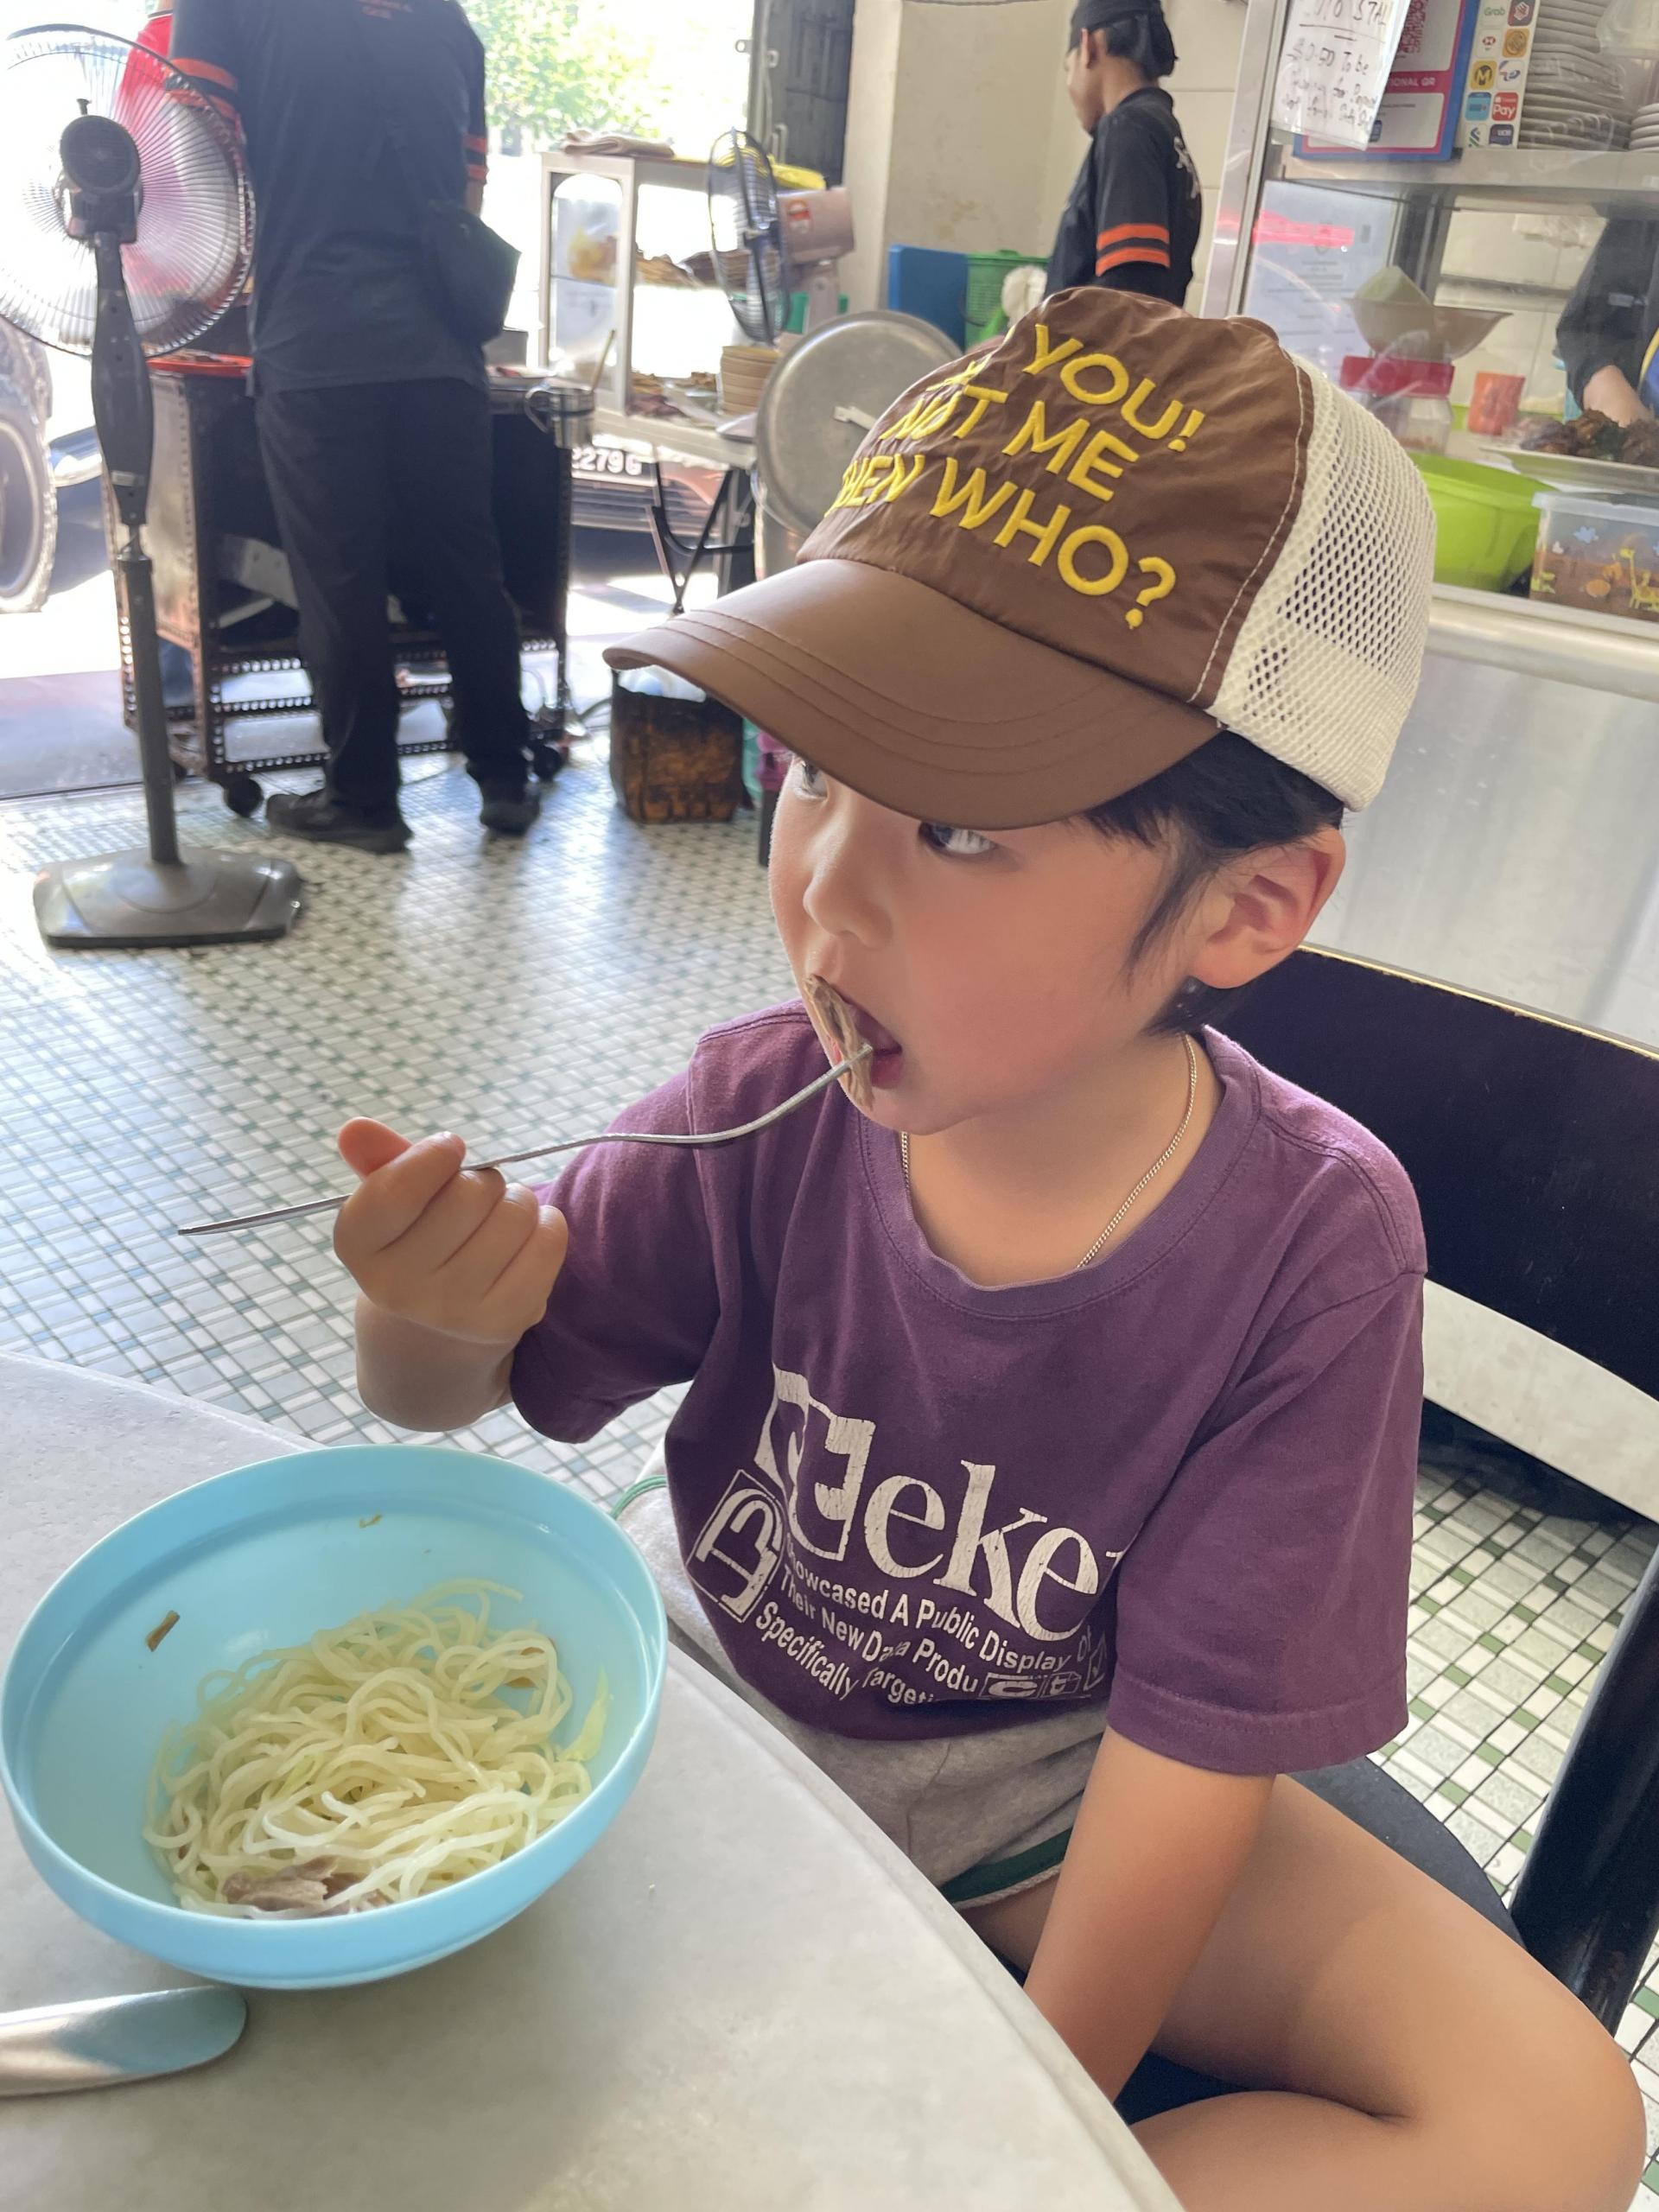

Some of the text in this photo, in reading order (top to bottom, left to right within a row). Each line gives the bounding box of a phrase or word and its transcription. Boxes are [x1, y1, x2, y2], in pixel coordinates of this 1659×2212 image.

[1484, 7, 1505, 16] Grab
[1493, 104, 1516, 119] Pay
[1022, 323, 1205, 453] YOU!
[879, 384, 1140, 502] NOT ME
[929, 456, 1176, 630] WHO?
[755, 1601, 860, 1701] Specifically
[780, 1564, 817, 1620] Their
[822, 1606, 865, 1651] New
[889, 1593, 908, 1627] A
[915, 1599, 980, 1649] Public
[979, 1630, 1072, 1674] Display
